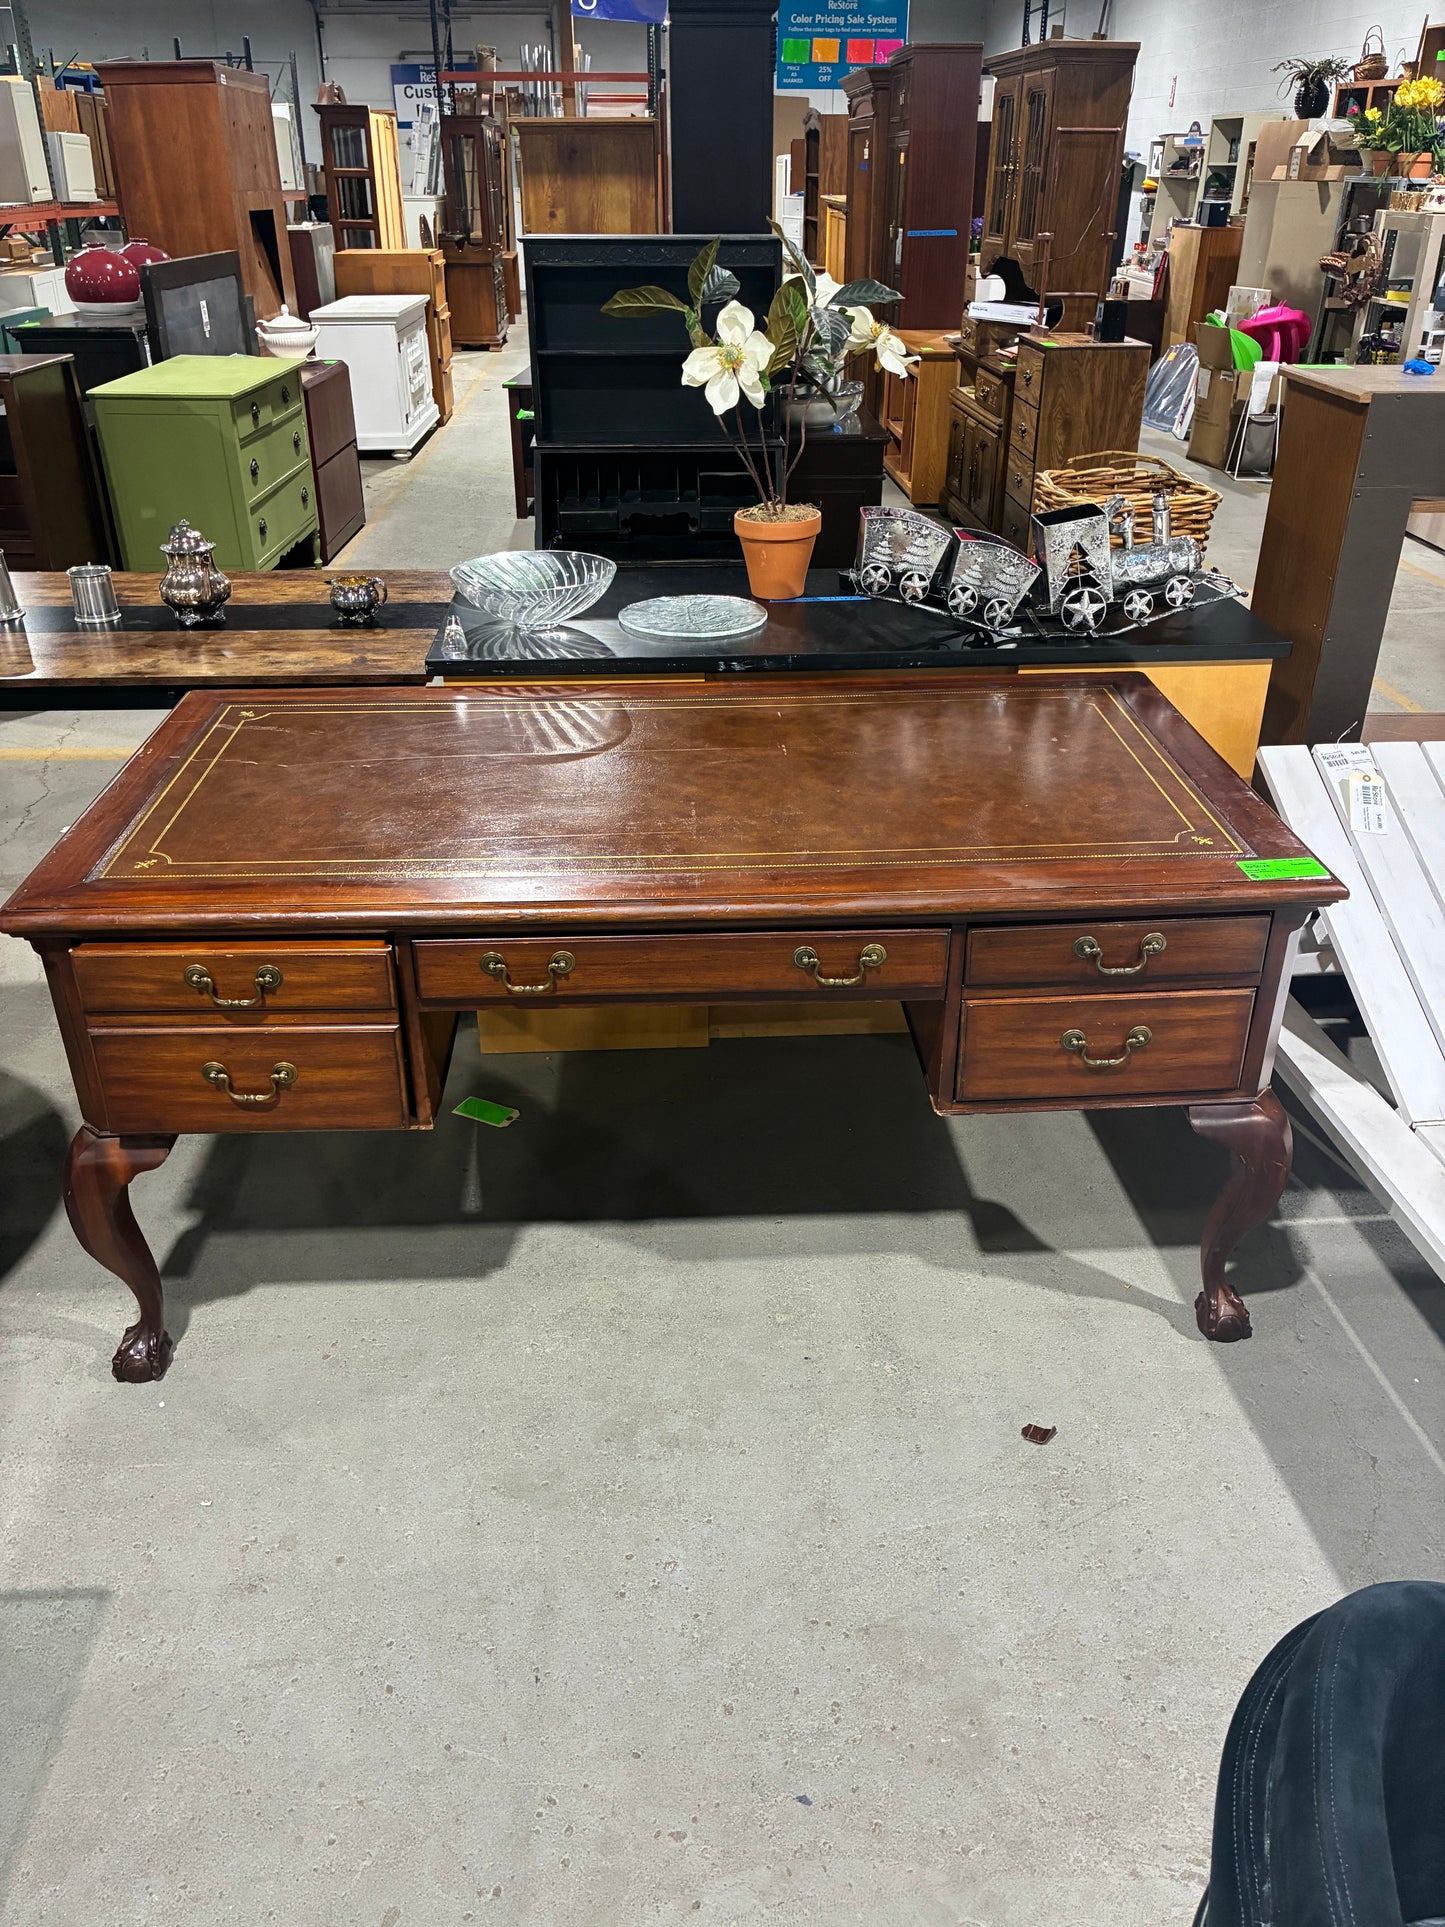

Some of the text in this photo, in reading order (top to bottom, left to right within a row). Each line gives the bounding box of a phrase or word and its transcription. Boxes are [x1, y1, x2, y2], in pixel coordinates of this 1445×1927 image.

[828, 0, 858, 10] ReStore
[790, 14, 897, 26] Color Pricing Sale System
